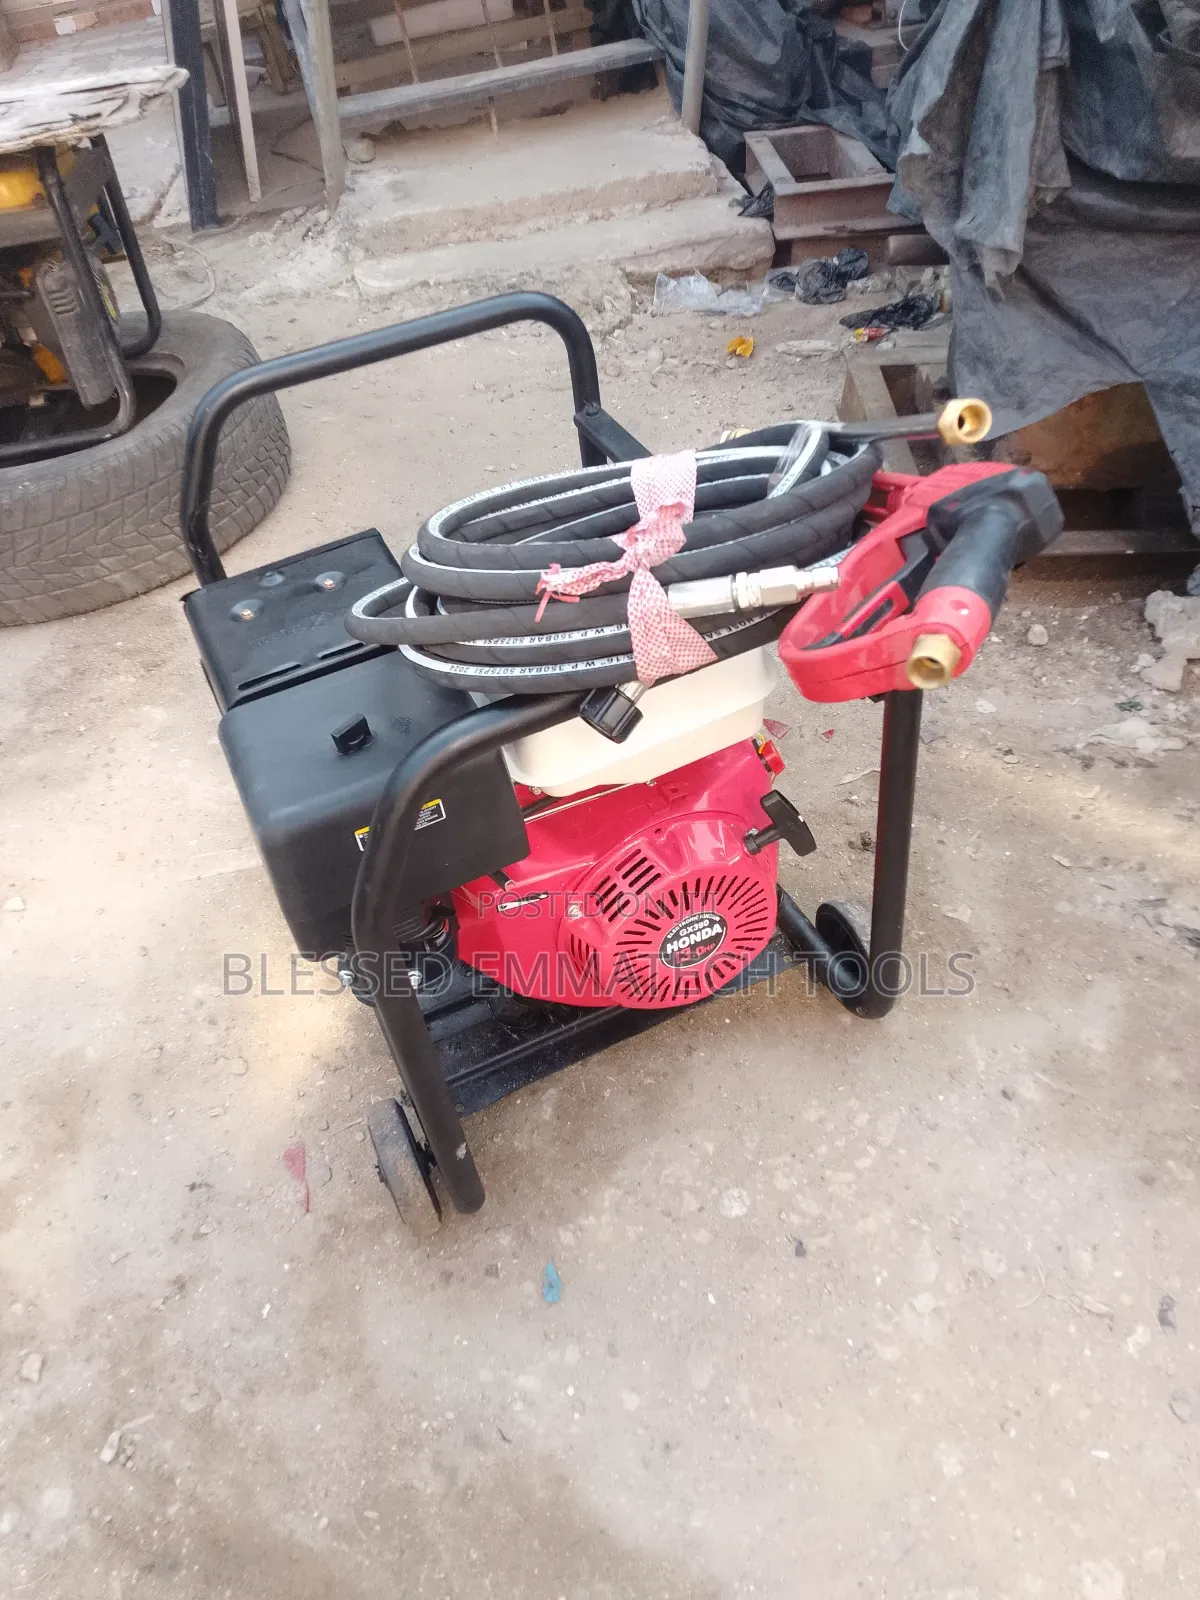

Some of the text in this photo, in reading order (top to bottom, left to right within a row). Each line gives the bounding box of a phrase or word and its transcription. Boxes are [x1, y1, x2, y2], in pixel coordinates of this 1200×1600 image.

[519, 664, 565, 674] 350BAR
[679, 919, 710, 937] GX390
[666, 923, 723, 955] HONDA
